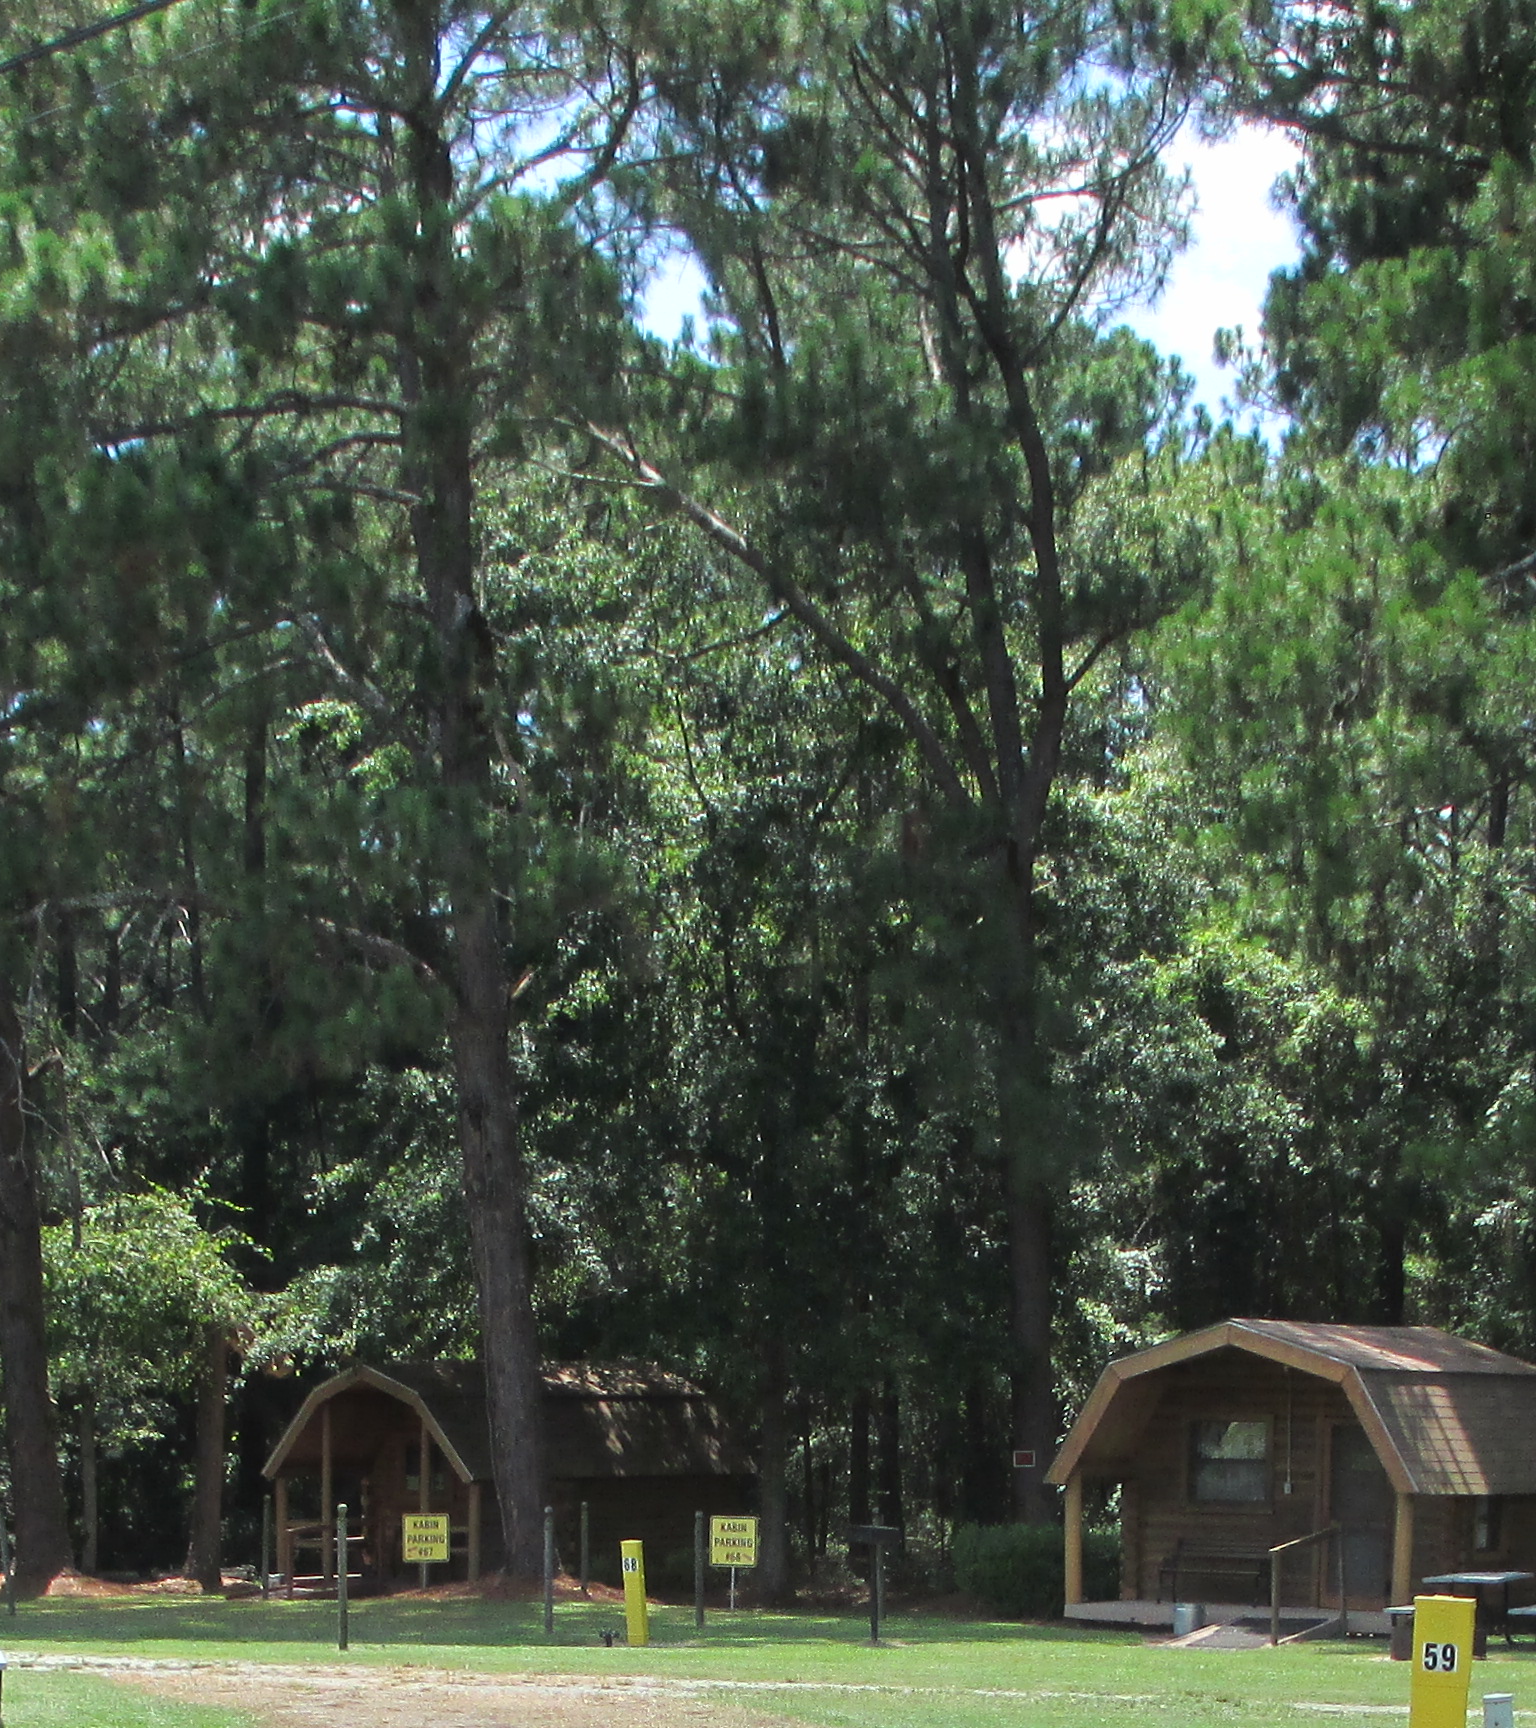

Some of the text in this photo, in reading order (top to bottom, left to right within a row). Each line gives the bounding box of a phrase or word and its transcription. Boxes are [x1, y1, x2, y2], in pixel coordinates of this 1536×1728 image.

[407, 1535, 445, 1544] PARKING
[714, 1538, 753, 1548] PARKING
[624, 1558, 637, 1572] 68
[1424, 1643, 1456, 1671] 59
